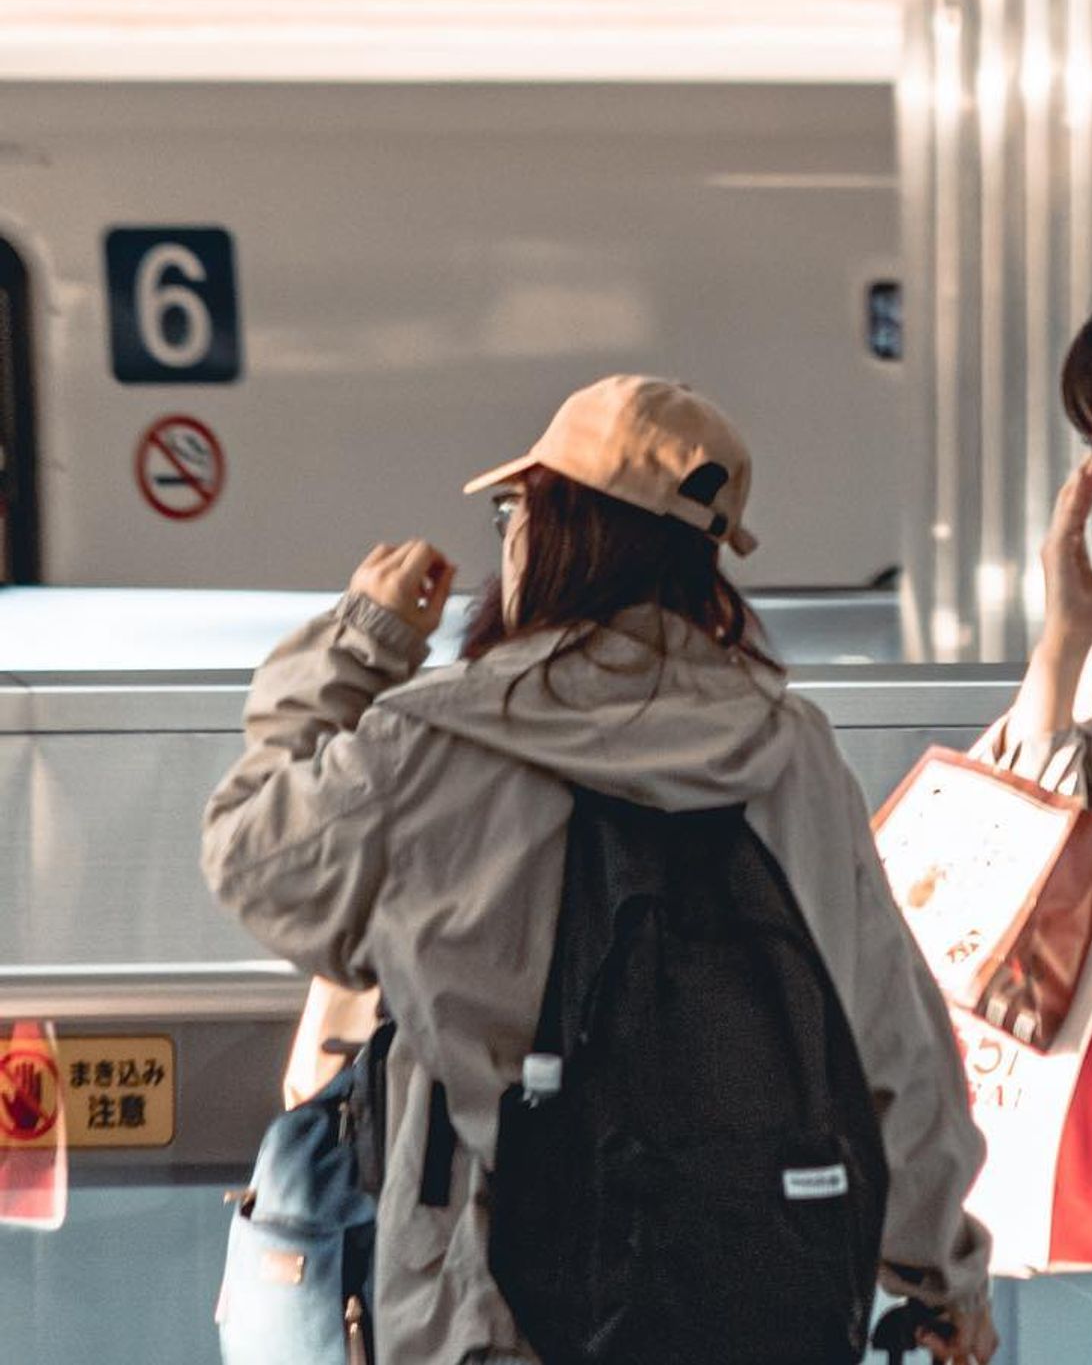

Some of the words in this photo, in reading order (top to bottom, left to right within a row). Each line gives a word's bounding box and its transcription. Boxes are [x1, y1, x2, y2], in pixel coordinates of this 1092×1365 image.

[134, 241, 212, 368] 6
[69, 1057, 166, 1088] まき込み
[86, 1093, 147, 1130] 注意
